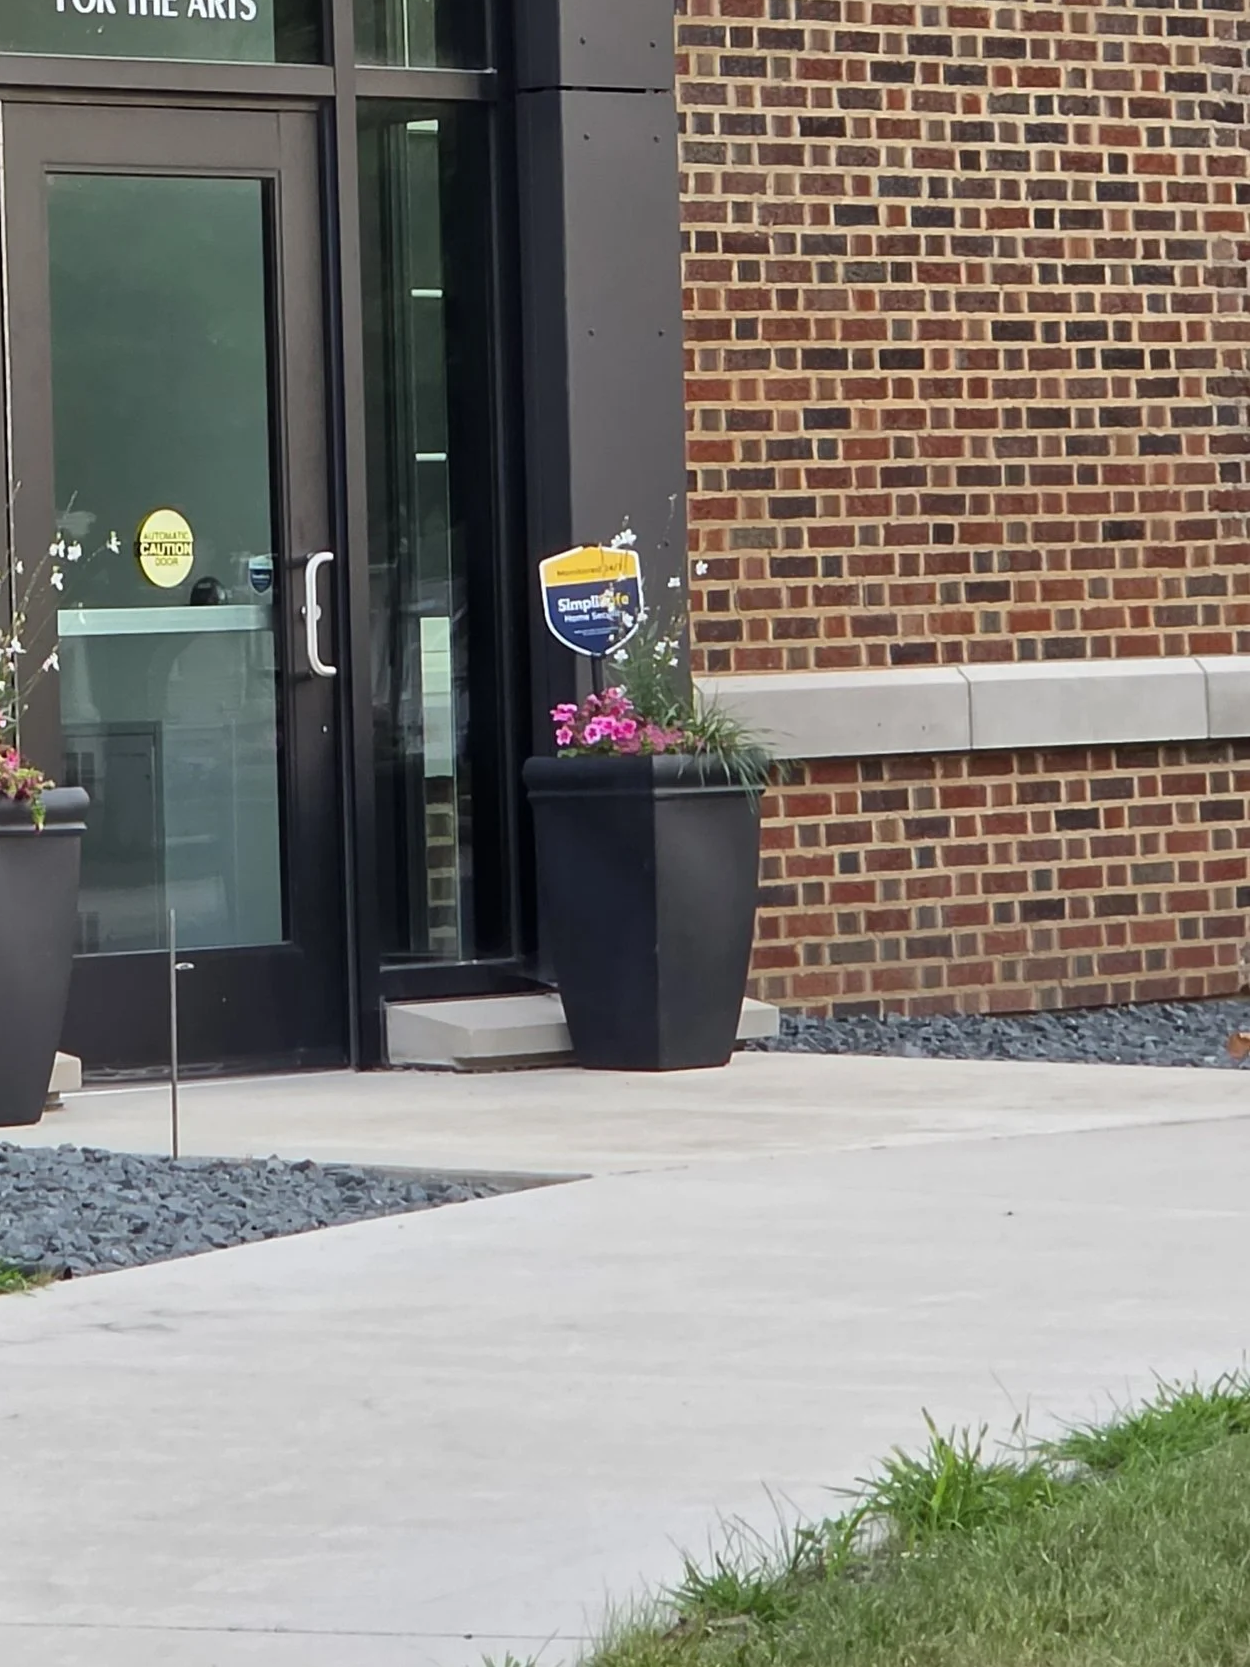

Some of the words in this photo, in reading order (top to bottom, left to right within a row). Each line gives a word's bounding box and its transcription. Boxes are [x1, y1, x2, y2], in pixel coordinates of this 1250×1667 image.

[143, 531, 189, 540] AUTOMATIC
[140, 542, 192, 555] CAUTION
[155, 557, 179, 566] DOOR
[557, 593, 630, 613] Simplife
[564, 614, 590, 623] Home
